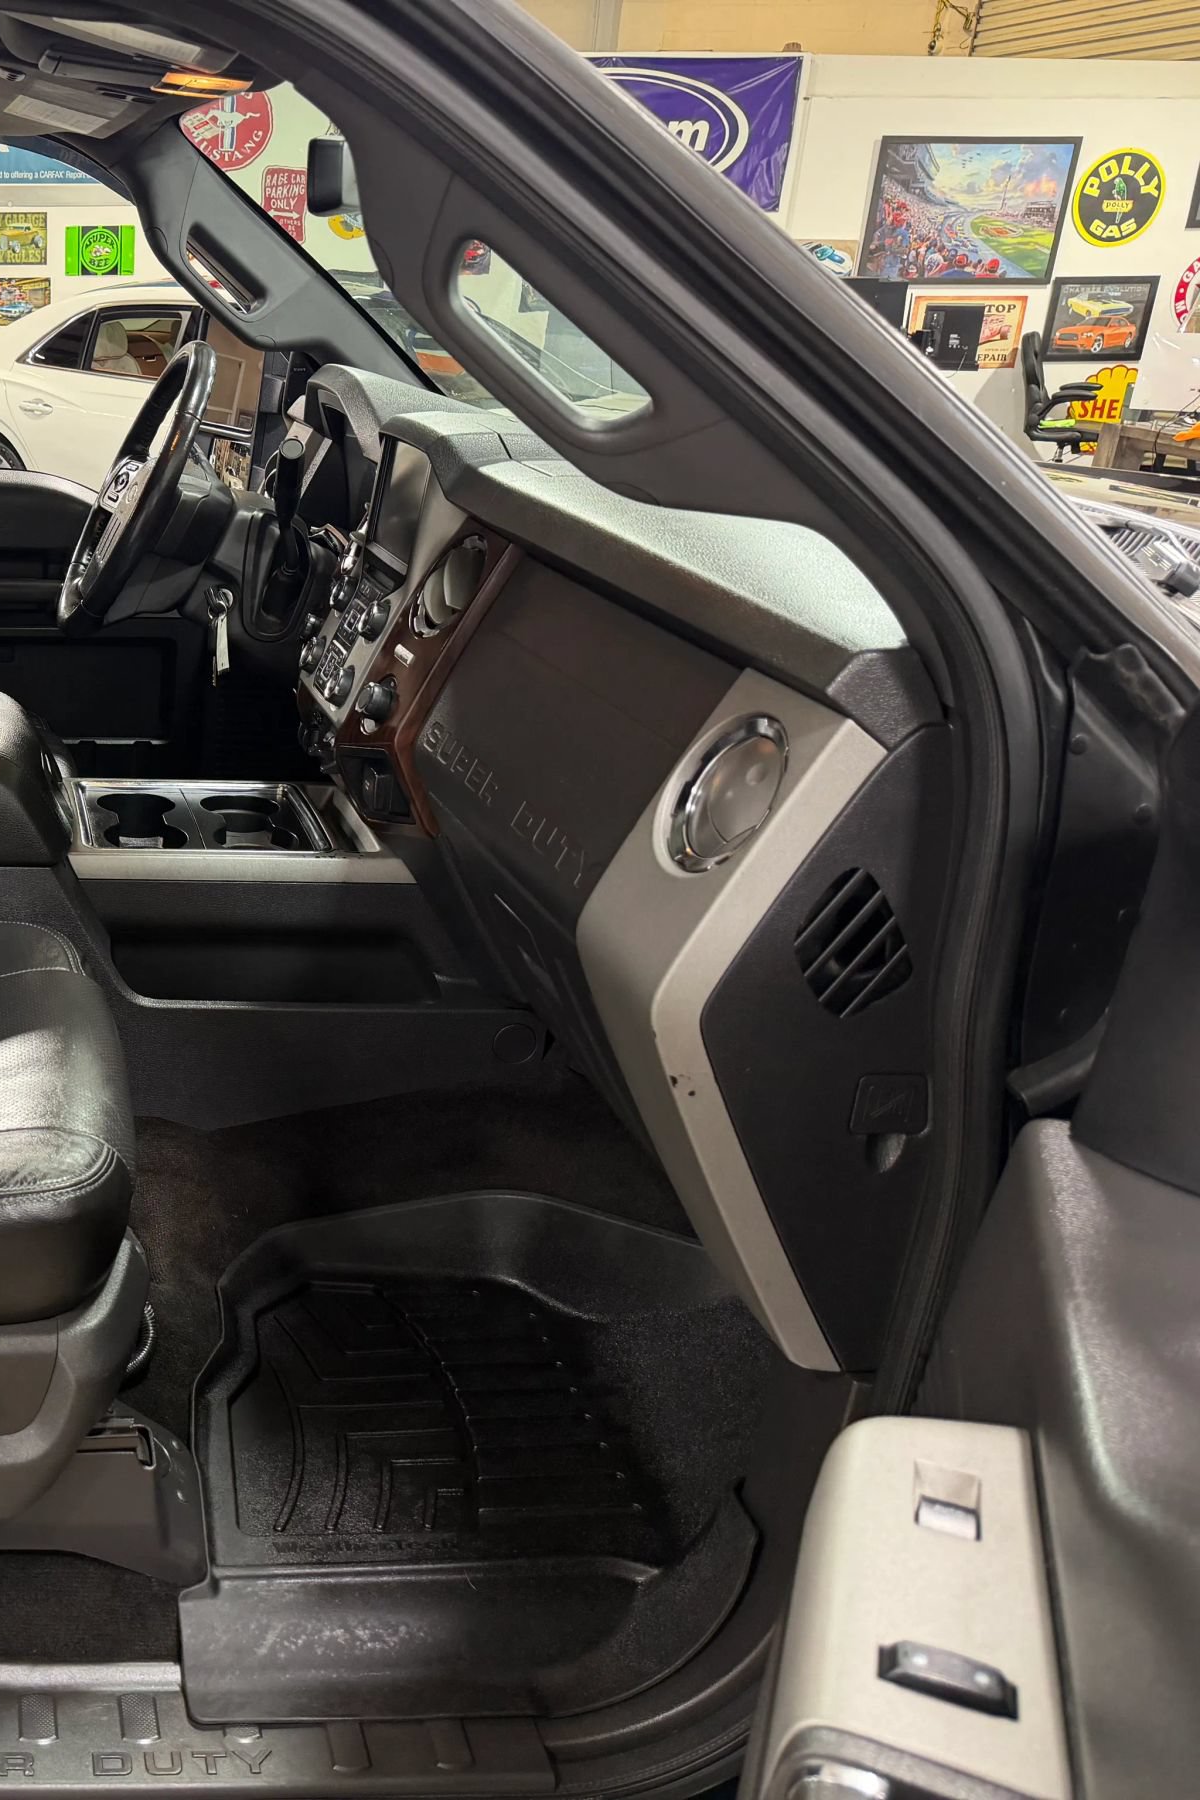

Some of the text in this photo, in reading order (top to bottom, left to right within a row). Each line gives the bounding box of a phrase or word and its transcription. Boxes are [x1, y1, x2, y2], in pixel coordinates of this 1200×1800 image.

[3, 170, 10, 179] to
[10, 170, 34, 181] offering
[39, 170, 64, 179] CARFAX
[291, 173, 306, 185] CAR
[1083, 156, 1159, 198] POLLY
[265, 184, 305, 199] PARKING
[270, 197, 298, 210] ONLY
[4, 213, 46, 228] GARAGE
[1089, 217, 1137, 239] GAS
[84, 233, 115, 249] SUPER
[89, 257, 110, 268] BEE
[984, 303, 1017, 313] TOP
[977, 353, 1007, 362] EPAIR
[1078, 399, 1121, 419] SHE
[91, 1749, 274, 1777] DUTY
